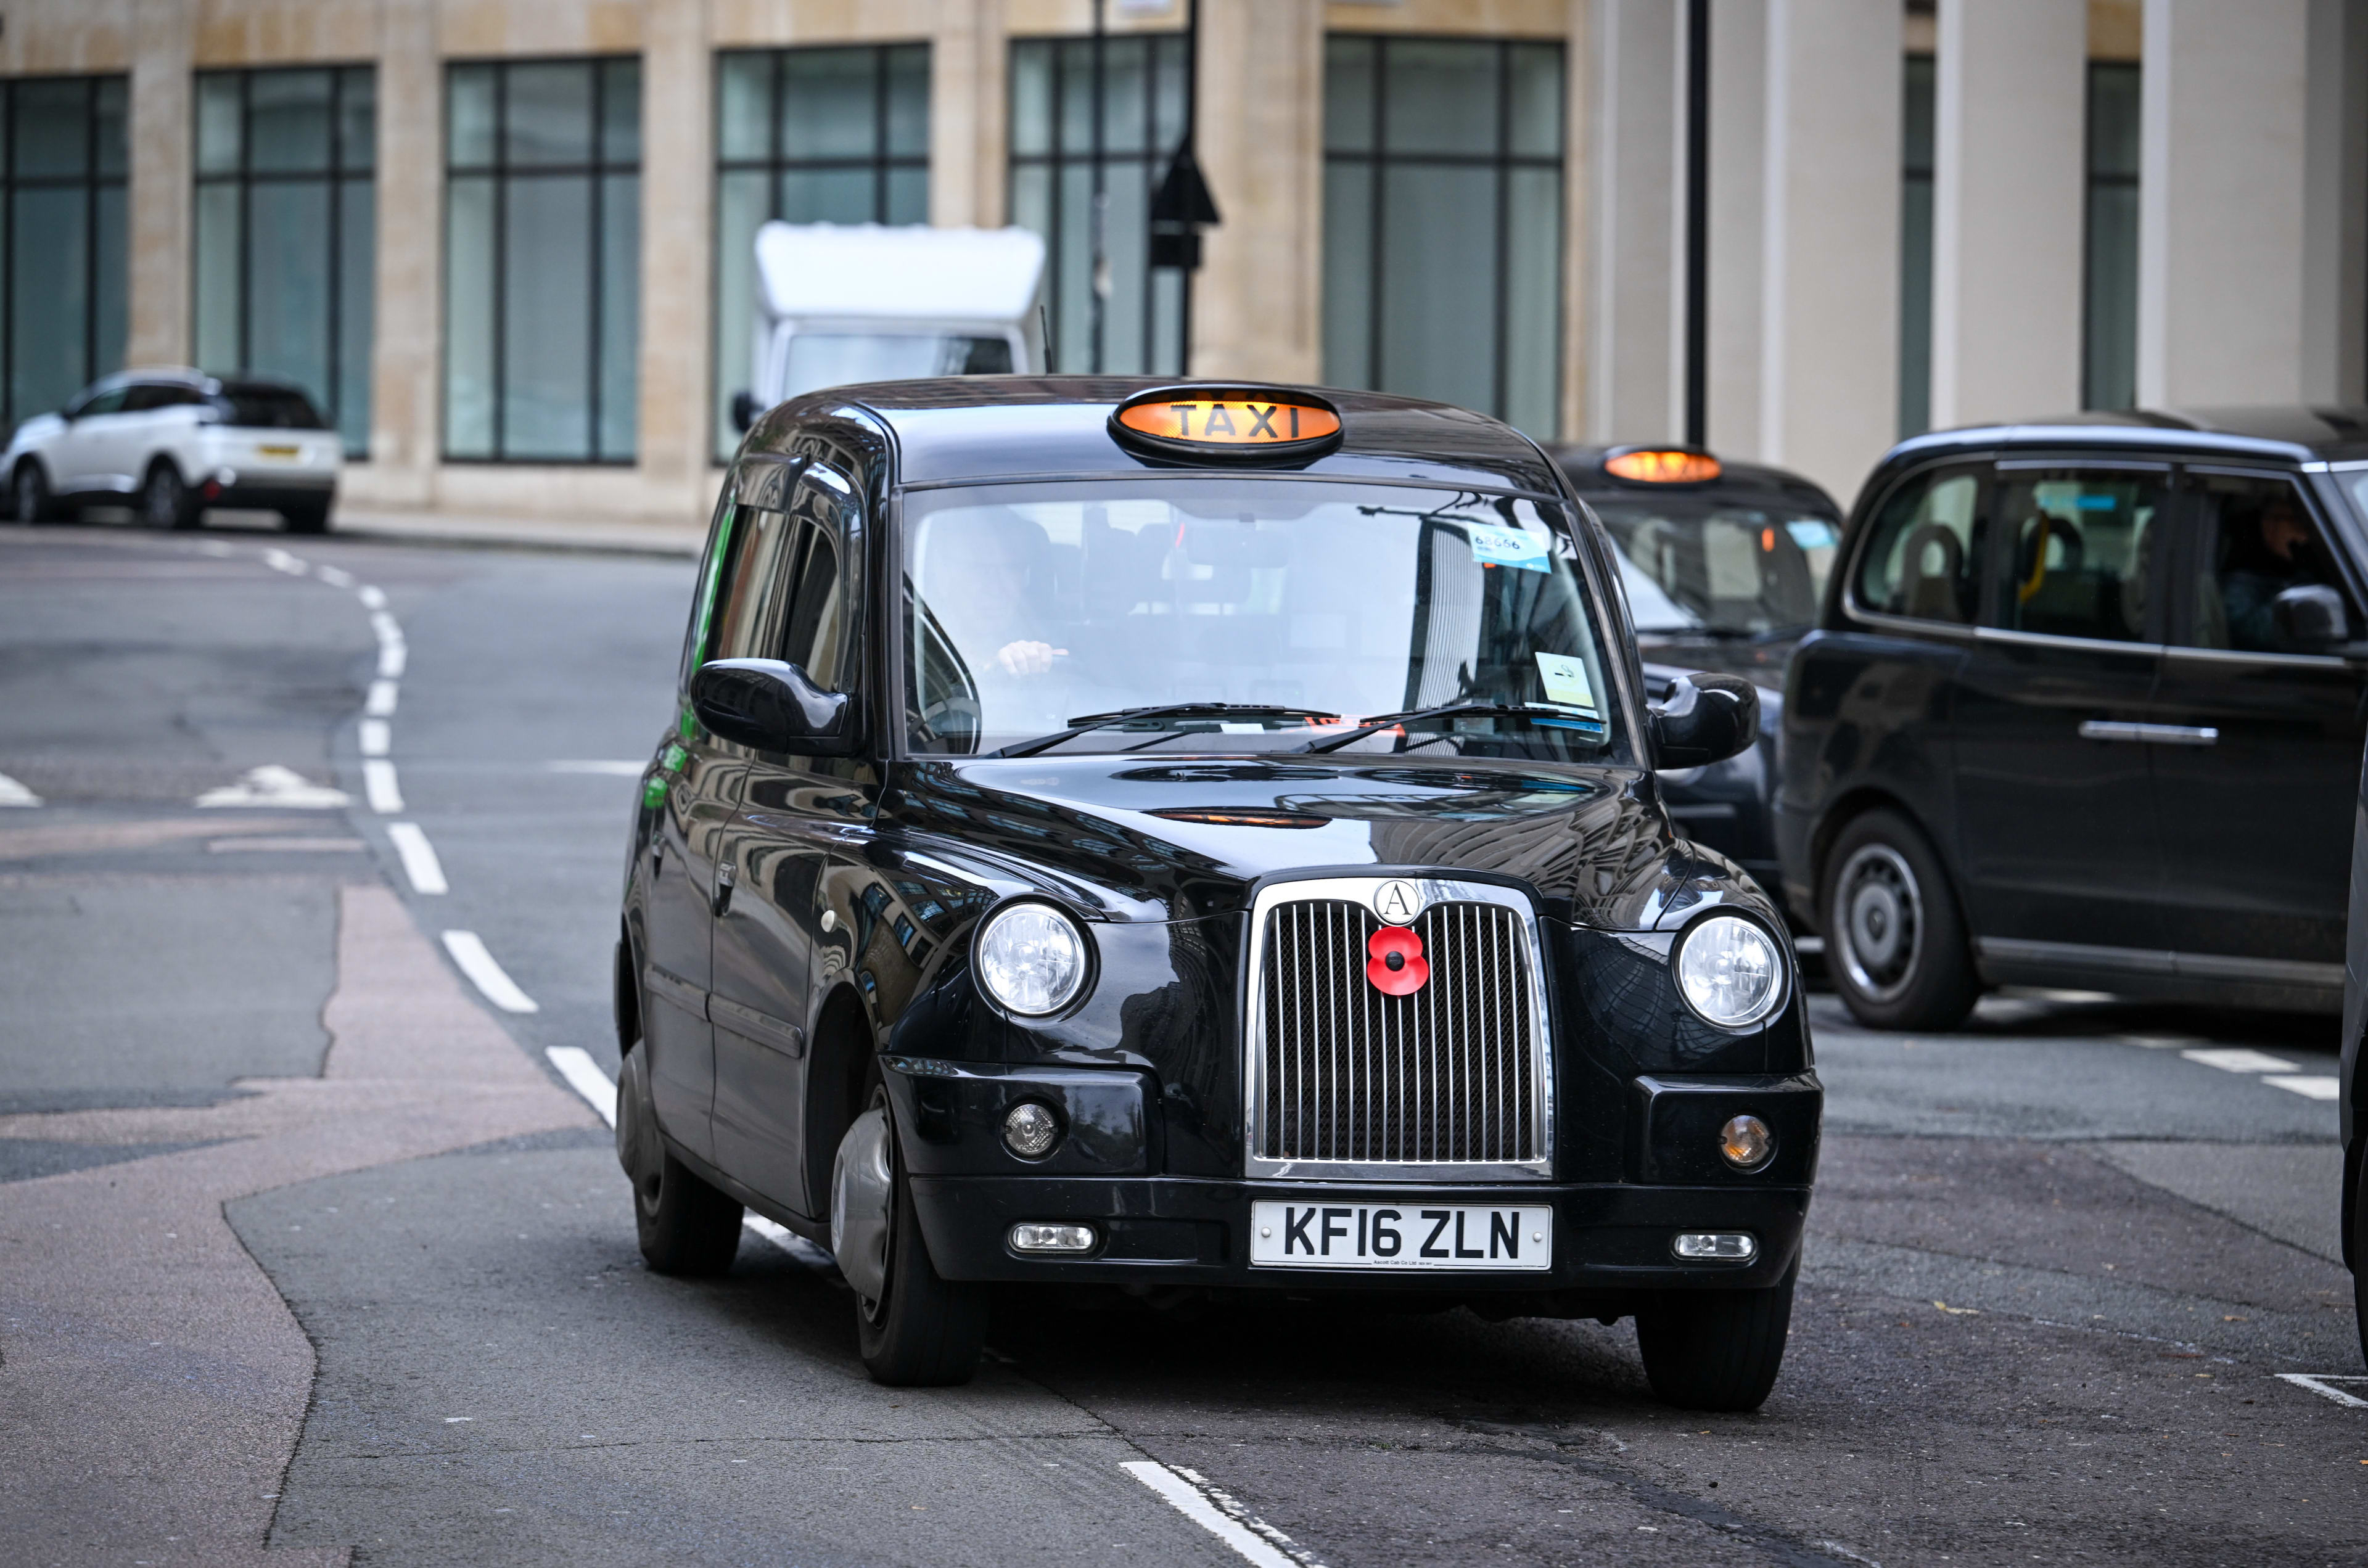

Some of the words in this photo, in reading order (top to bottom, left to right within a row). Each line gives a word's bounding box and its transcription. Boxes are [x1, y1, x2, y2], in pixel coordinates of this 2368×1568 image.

[1170, 404, 1299, 438] TAXI
[1476, 536, 1519, 549] 68666
[1384, 882, 1412, 915] A
[1285, 1207, 1402, 1257] KF16
[1420, 1210, 1520, 1259] ZLN
